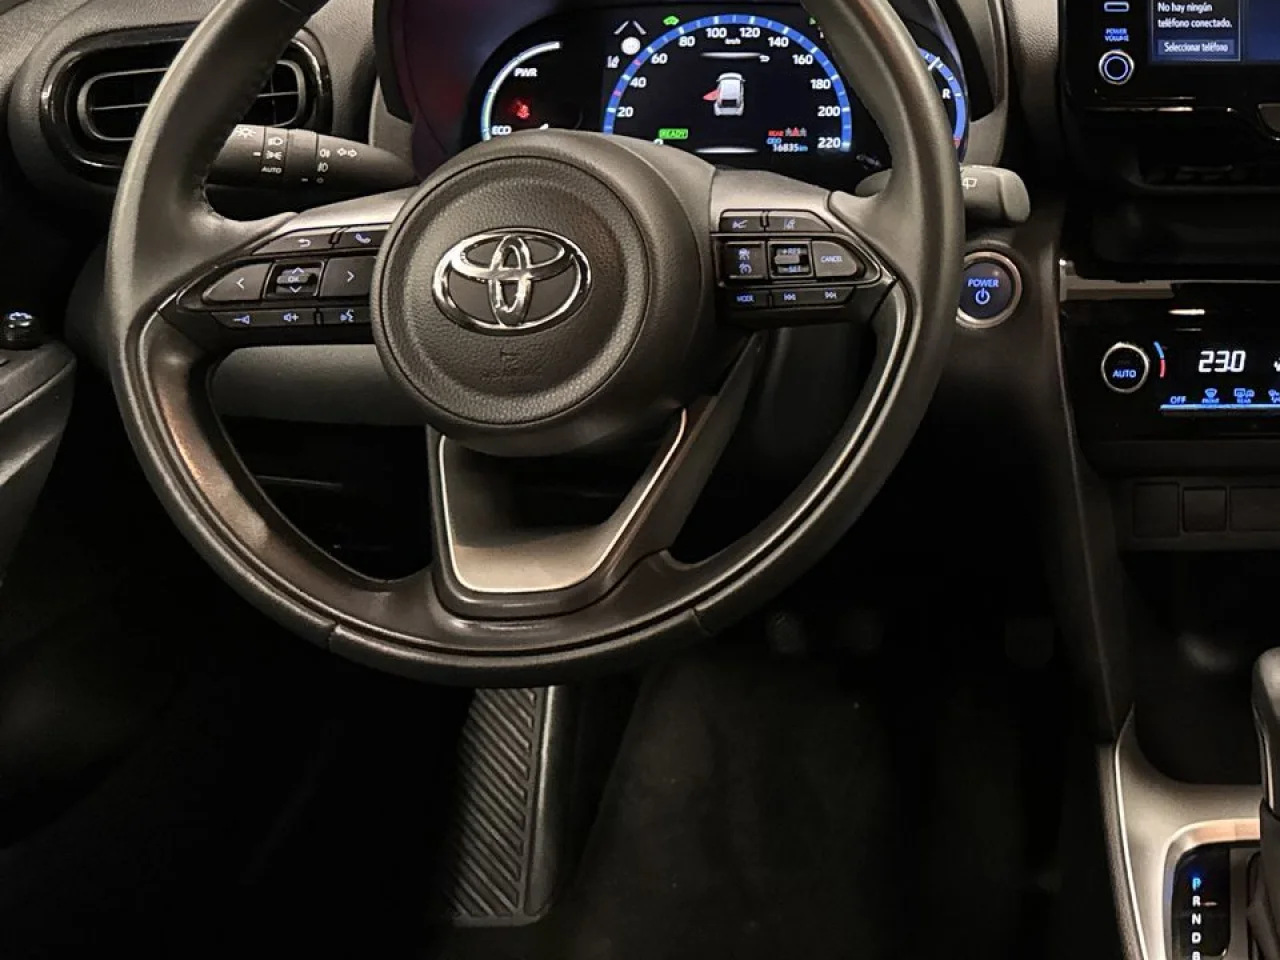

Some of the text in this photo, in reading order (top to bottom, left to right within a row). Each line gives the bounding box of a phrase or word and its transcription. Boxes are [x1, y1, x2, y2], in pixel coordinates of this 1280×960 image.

[1157, 2, 1212, 14] No hay ningún
[1158, 18, 1190, 28] teléfono
[706, 28, 728, 39] 100
[739, 27, 760, 38] 120
[679, 36, 696, 47] 80
[768, 37, 789, 48] 140
[1164, 42, 1229, 52] Seleccionar teléfono
[651, 53, 668, 64] 60
[792, 54, 813, 65] 160
[514, 68, 538, 77] PWR
[630, 77, 647, 88] 40
[810, 79, 831, 90] 180
[616, 107, 634, 117] 20
[817, 106, 841, 117] 200
[492, 125, 512, 135] ECO
[817, 138, 841, 149] 220
[261, 166, 282, 174] AUTO
[967, 279, 999, 288] POWER
[1112, 369, 1136, 378] AUTO
[1170, 396, 1187, 404] OFF
[1192, 878, 1201, 889] P
[1192, 896, 1201, 907] R
[1191, 914, 1201, 925] N
[1191, 932, 1201, 944] D
